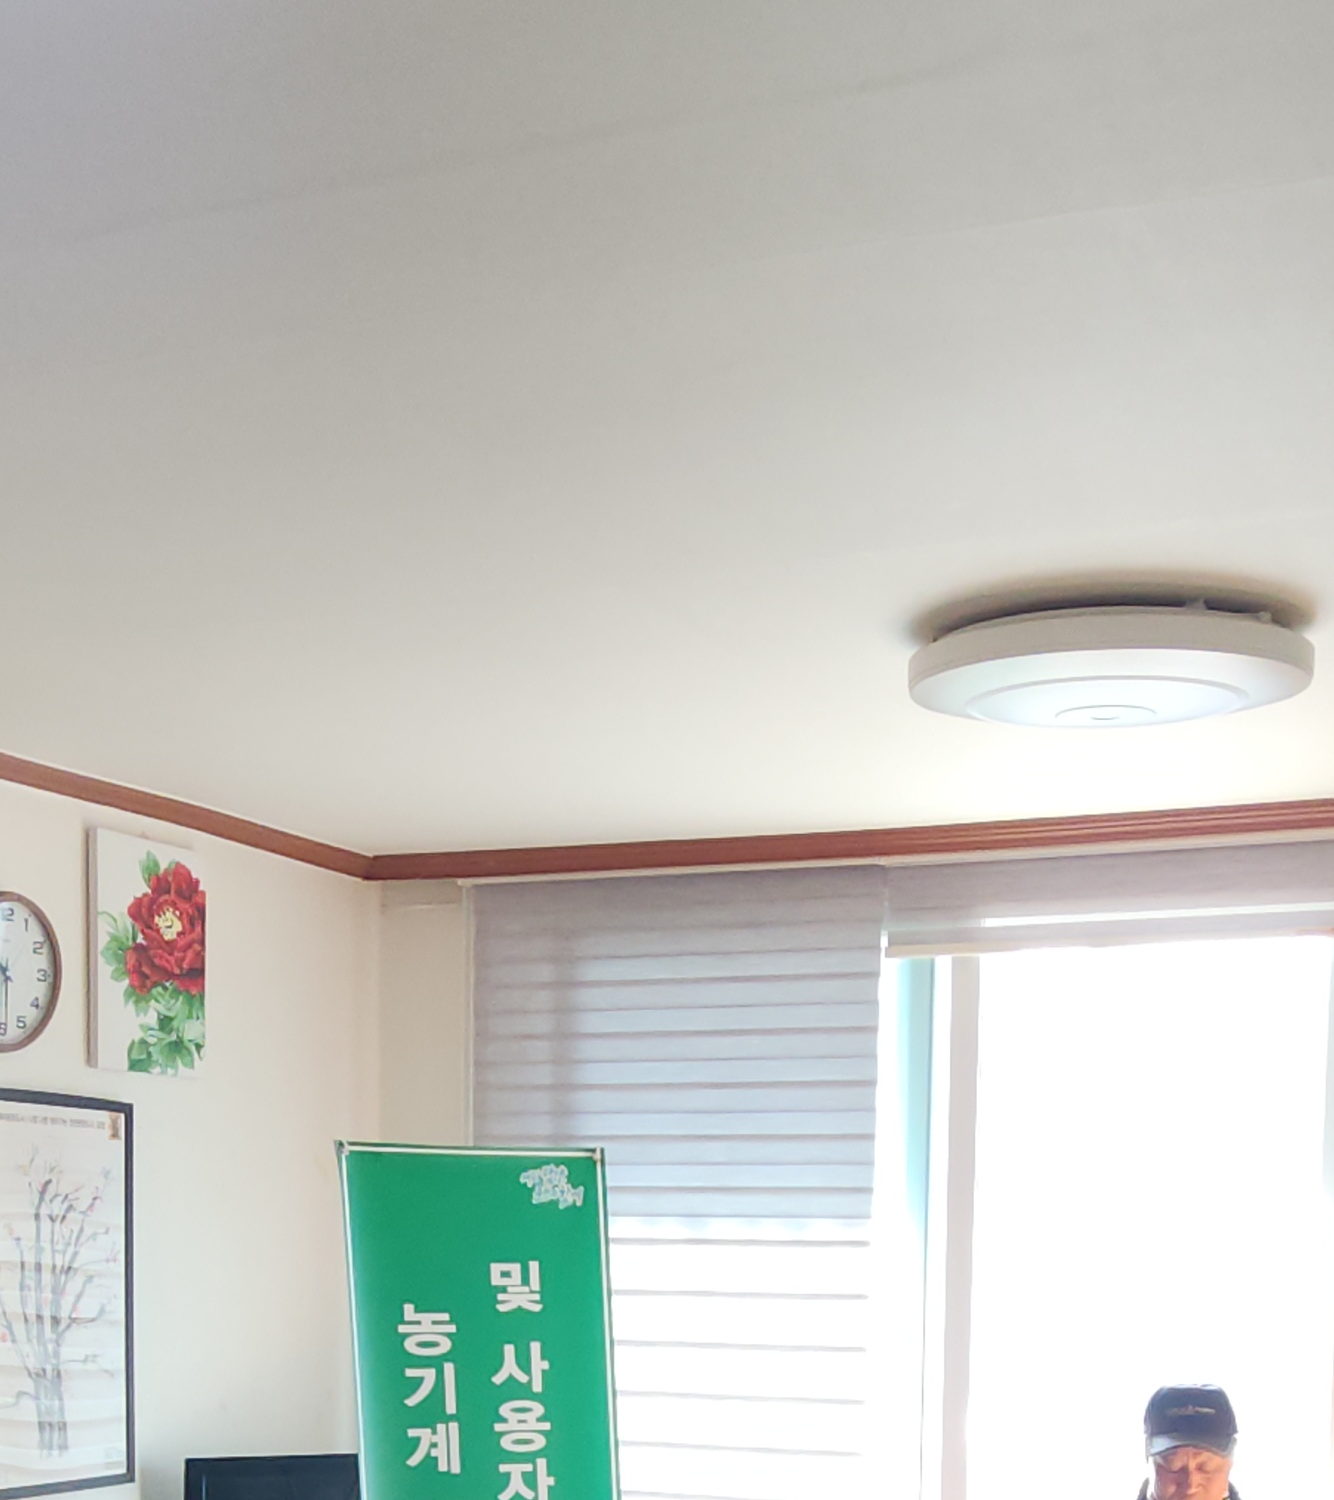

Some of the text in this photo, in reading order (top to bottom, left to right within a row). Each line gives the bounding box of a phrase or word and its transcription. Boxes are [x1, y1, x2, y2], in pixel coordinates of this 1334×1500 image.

[0, 907, 14, 922] 12
[32, 941, 44, 955] 2
[37, 968, 47, 982] 3
[30, 996, 39, 1010] 4
[16, 1015, 27, 1029] 5
[489, 1260, 544, 1313] 및
[397, 1303, 461, 1475] 농기계
